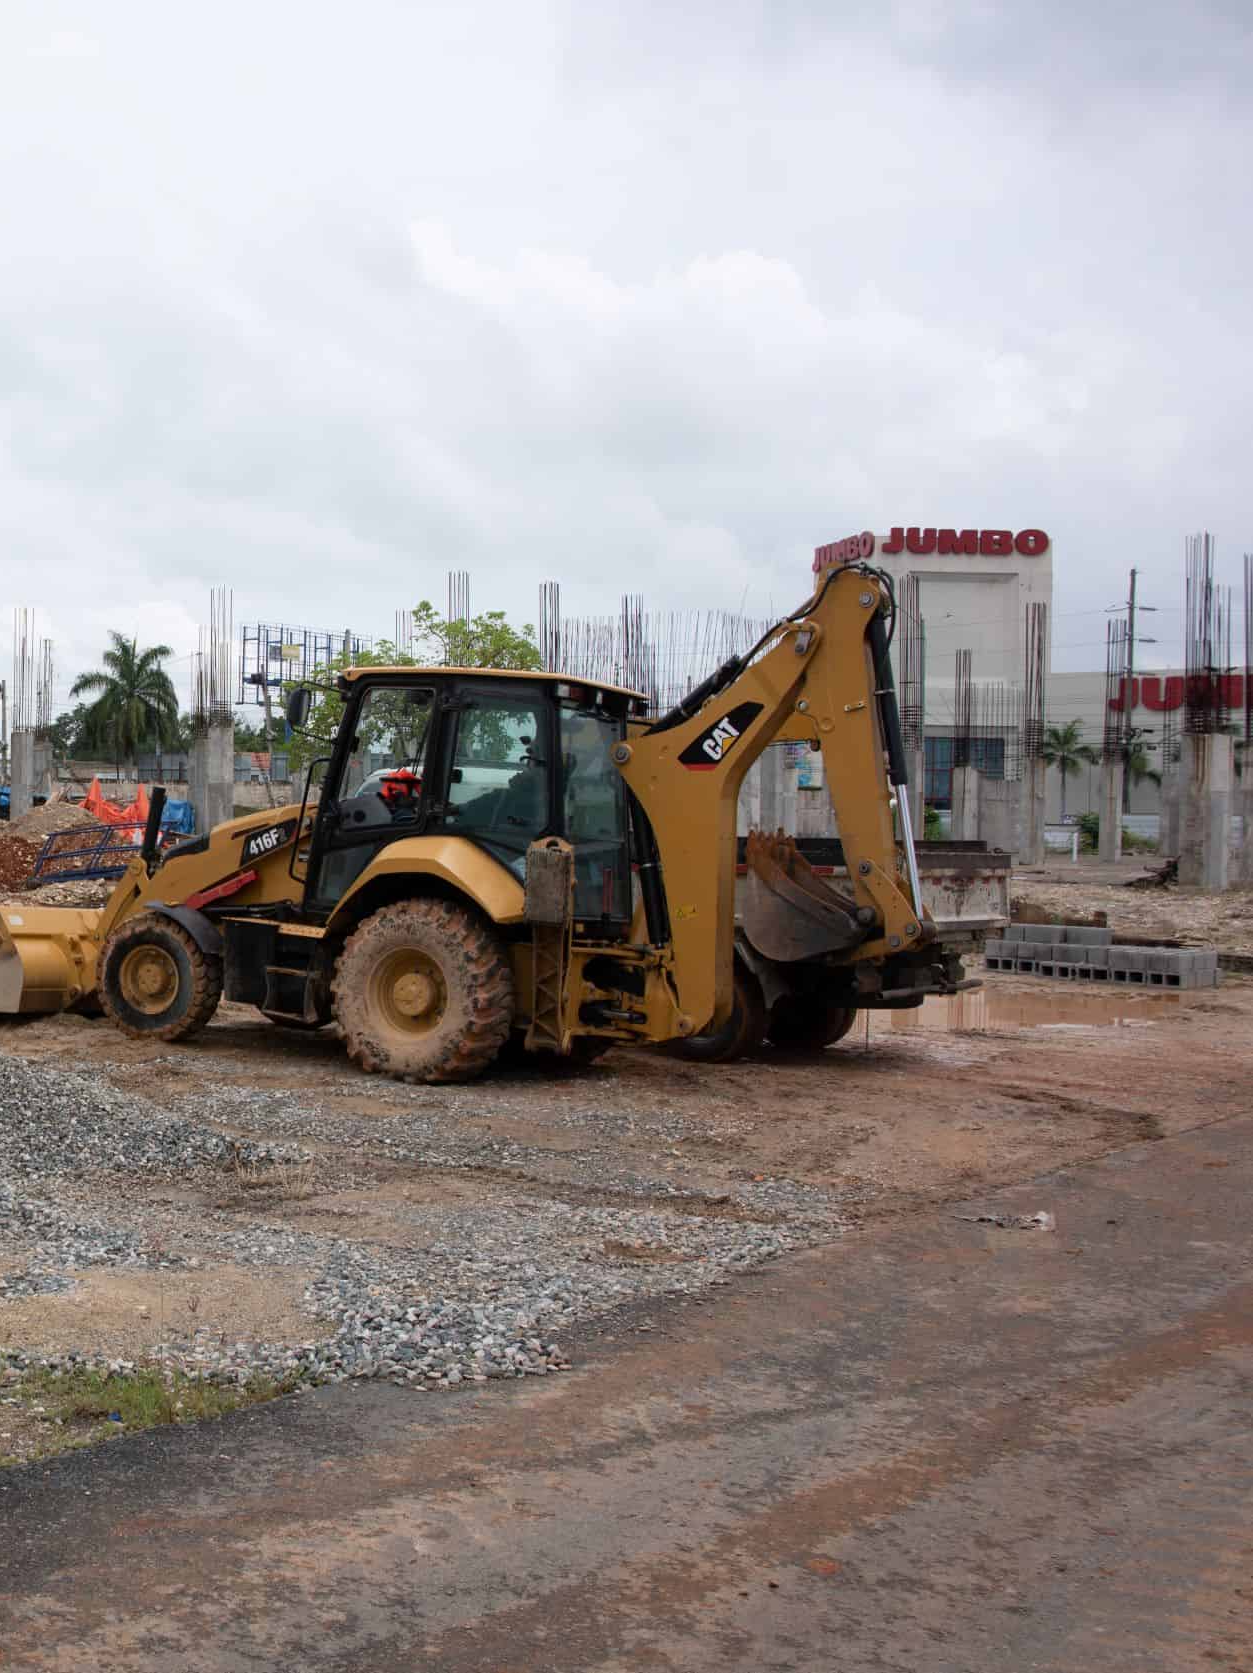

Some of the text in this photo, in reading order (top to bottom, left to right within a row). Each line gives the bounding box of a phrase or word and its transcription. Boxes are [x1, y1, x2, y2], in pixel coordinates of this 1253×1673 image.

[812, 531, 873, 572] JUMBO
[882, 527, 1049, 555] JUMBO
[1108, 674, 1253, 712] JUM
[702, 717, 739, 760] CAT
